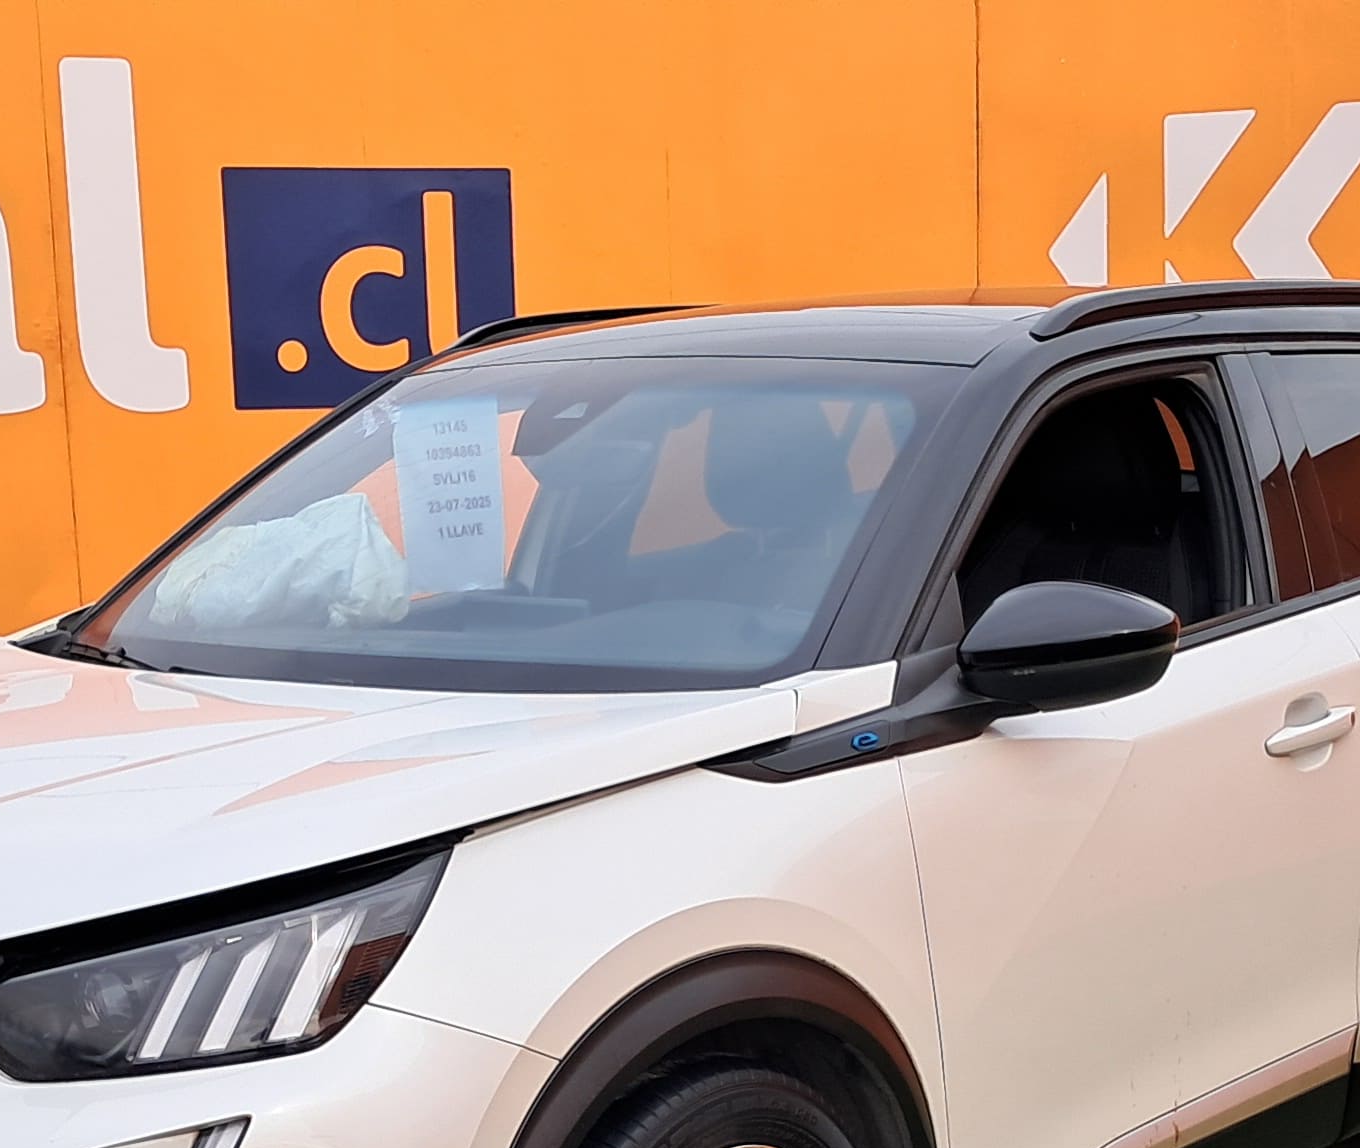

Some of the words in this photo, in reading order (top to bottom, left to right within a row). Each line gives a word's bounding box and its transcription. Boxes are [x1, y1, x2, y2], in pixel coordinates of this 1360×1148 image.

[432, 469, 477, 486] SVLJ16
[426, 494, 493, 514] 23-07-2025
[446, 521, 485, 539] LLAVE
